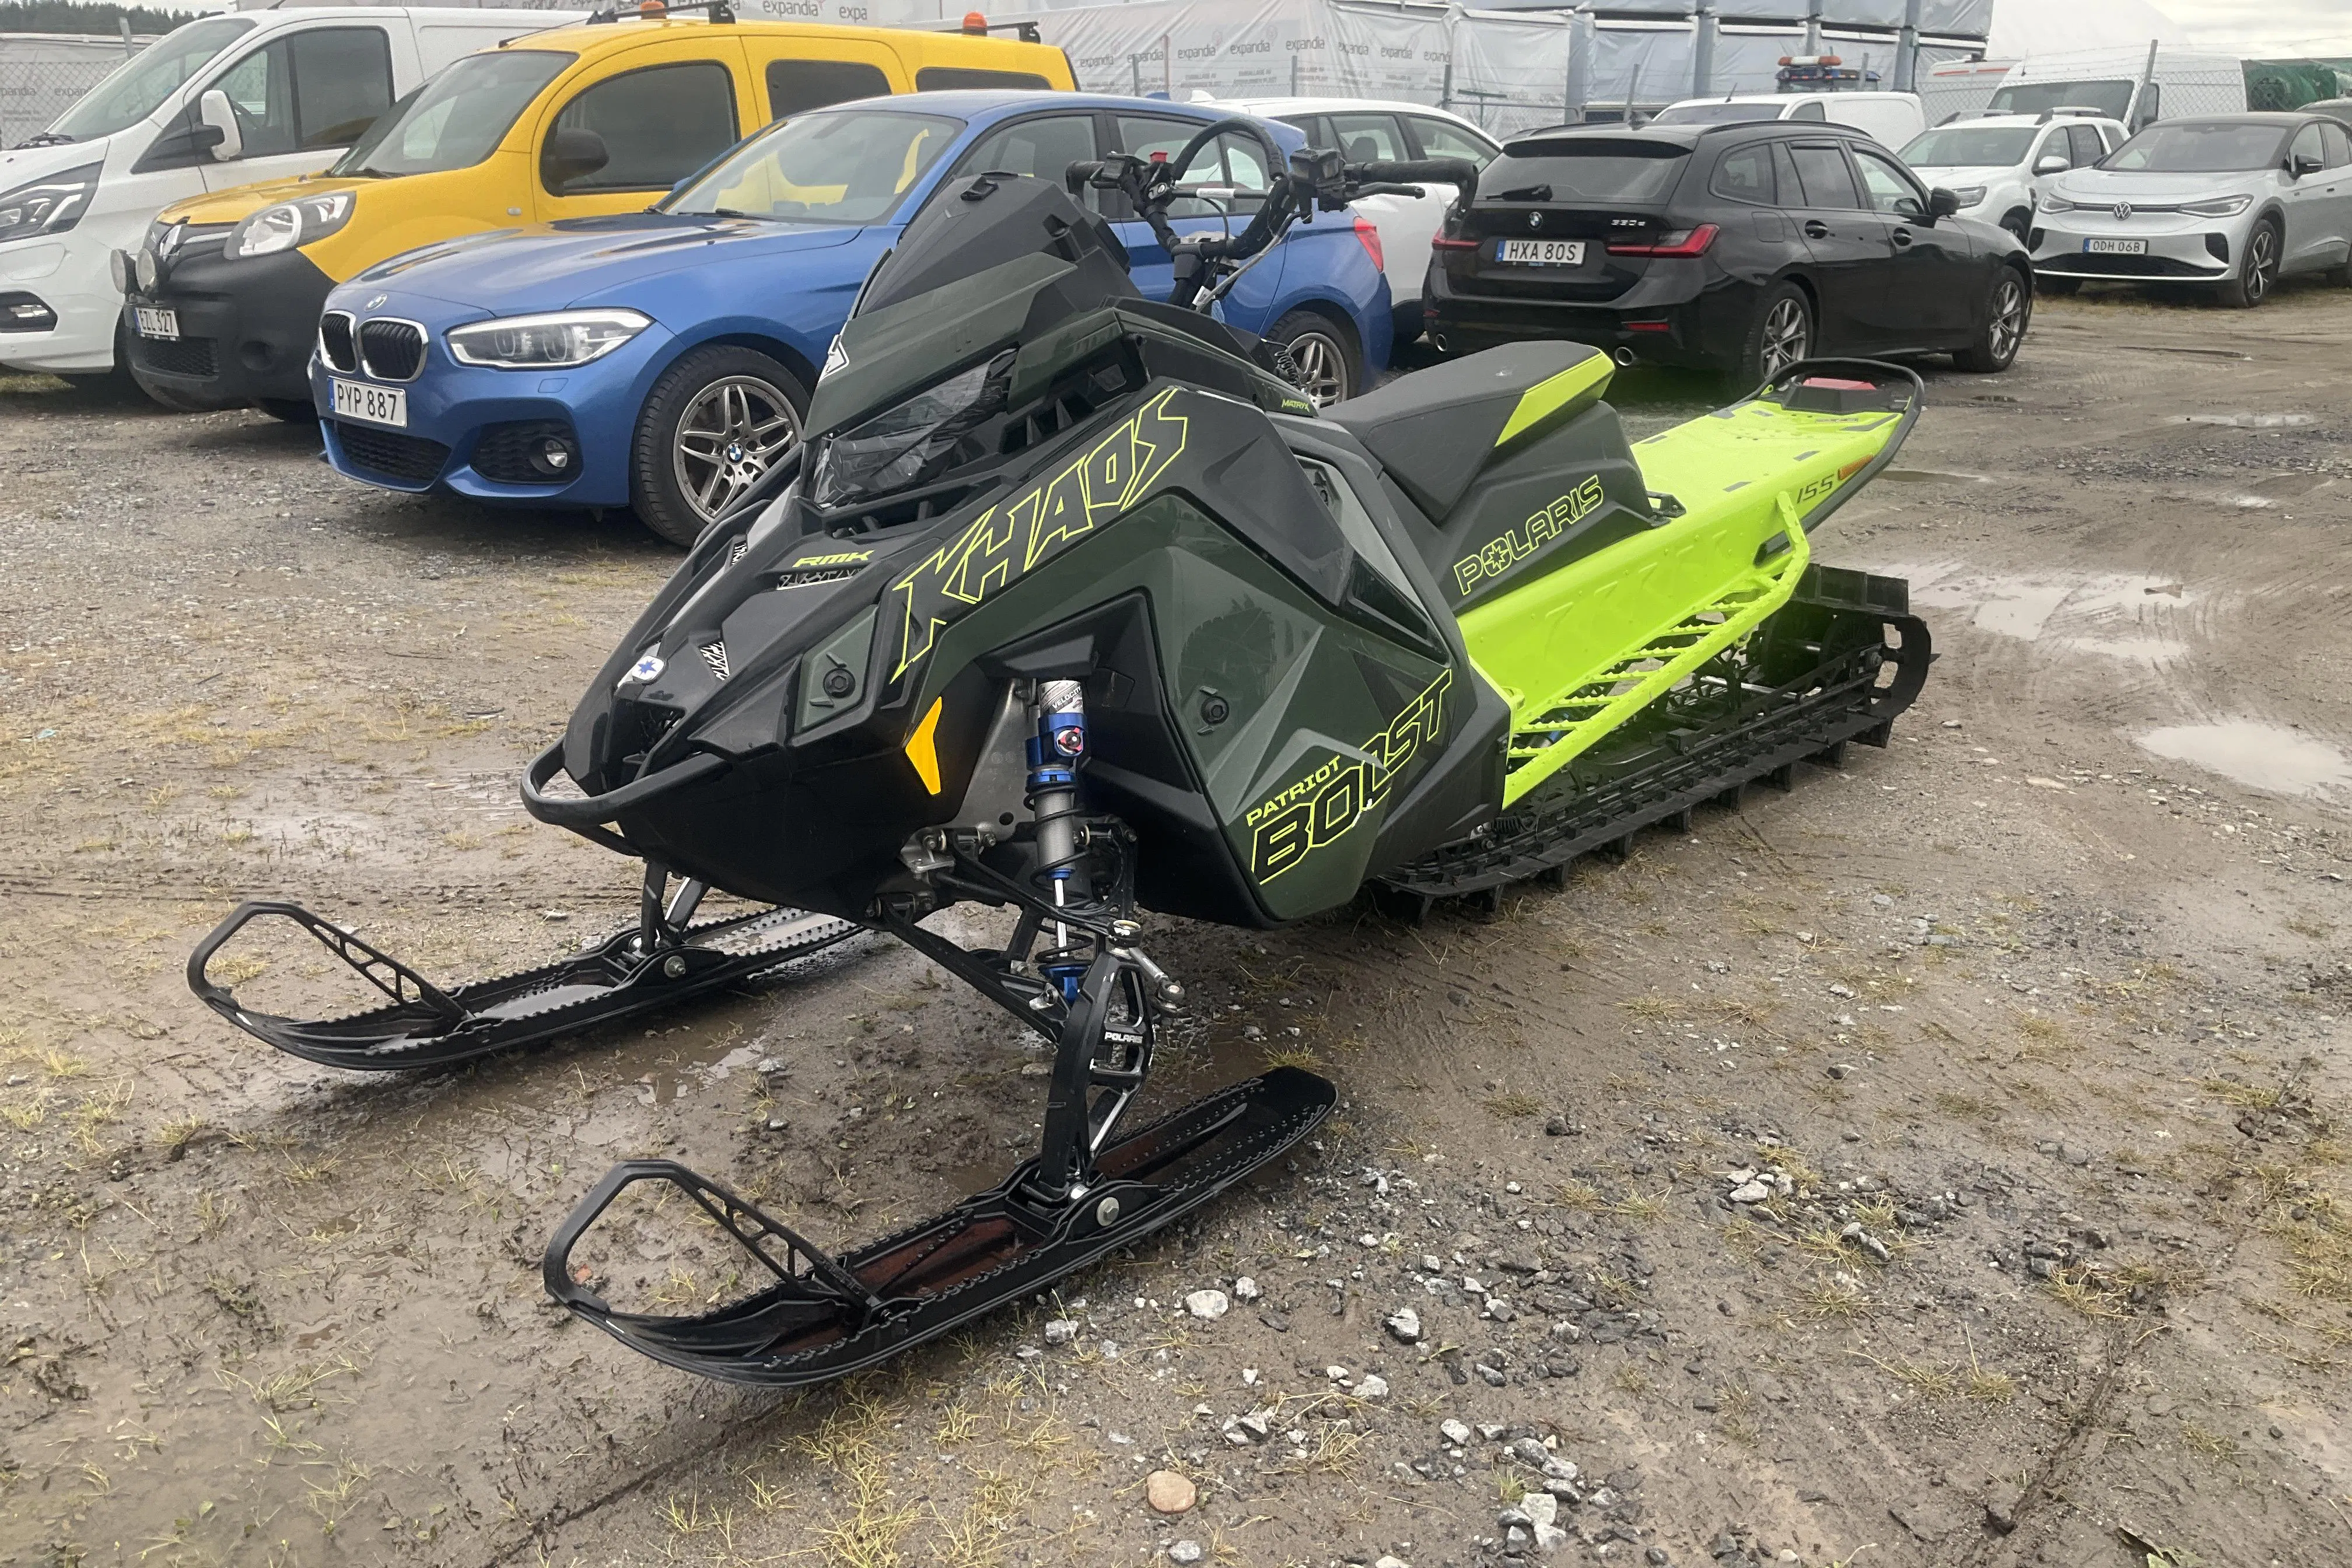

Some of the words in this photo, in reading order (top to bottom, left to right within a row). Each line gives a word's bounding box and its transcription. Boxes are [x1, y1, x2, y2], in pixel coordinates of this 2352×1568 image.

[763, 0, 818, 18] expandia
[1178, 44, 1216, 60] expandia
[1230, 40, 1270, 57] expandia
[1286, 36, 1325, 52] expandia
[1509, 242, 1539, 260] HXA
[1544, 243, 1577, 261] 80S
[2093, 241, 2115, 251] ODH
[2118, 242, 2140, 253] 06B
[139, 310, 156, 331] EZL
[155, 312, 173, 333] 327
[337, 384, 362, 414] PYP
[367, 390, 397, 421] 887
[1796, 474, 1835, 505] 155
[890, 387, 1188, 684] KHAOS
[1453, 475, 1604, 596] POLARIS
[792, 550, 875, 568] RMK
[1251, 668, 1452, 886] BOOST
[1246, 755, 1341, 827] PATRIOT
